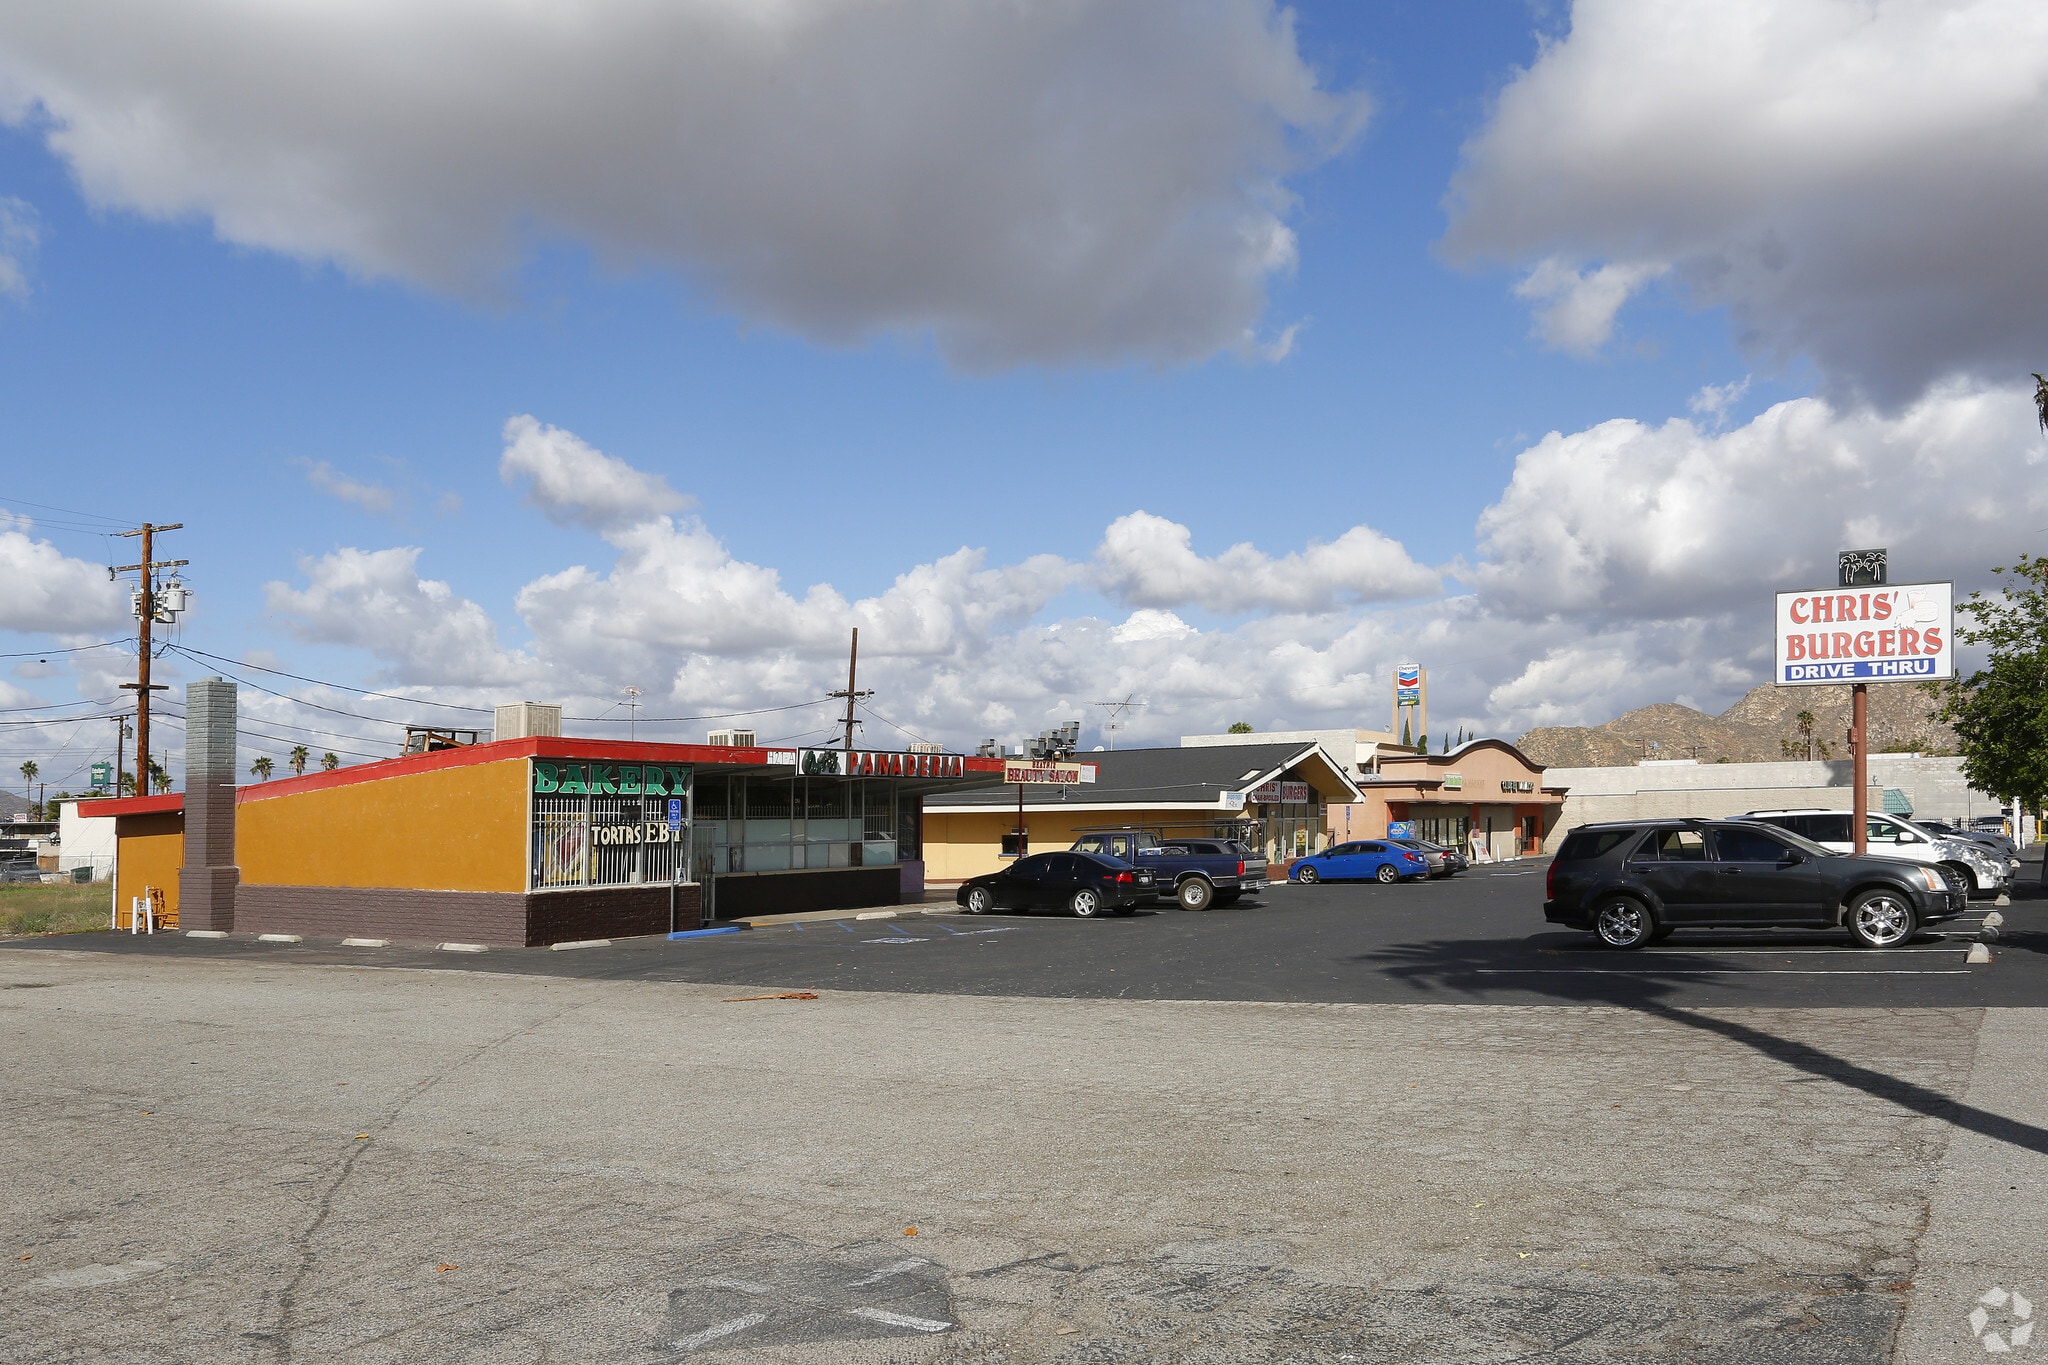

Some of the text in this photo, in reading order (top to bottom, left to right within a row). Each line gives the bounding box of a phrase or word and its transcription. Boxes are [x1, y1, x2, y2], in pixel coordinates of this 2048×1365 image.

[1790, 591, 1898, 624] CHRIS'
[1786, 627, 1943, 661] BURGERS
[1790, 659, 1930, 679] DRIVE THRU
[847, 751, 962, 777] PANADERIA
[1007, 768, 1044, 782] BEAUTY
[1049, 769, 1079, 783] SALON
[534, 763, 692, 796] BAKERY
[1283, 785, 1307, 800] BURGERS
[591, 825, 641, 846] TORTAS
